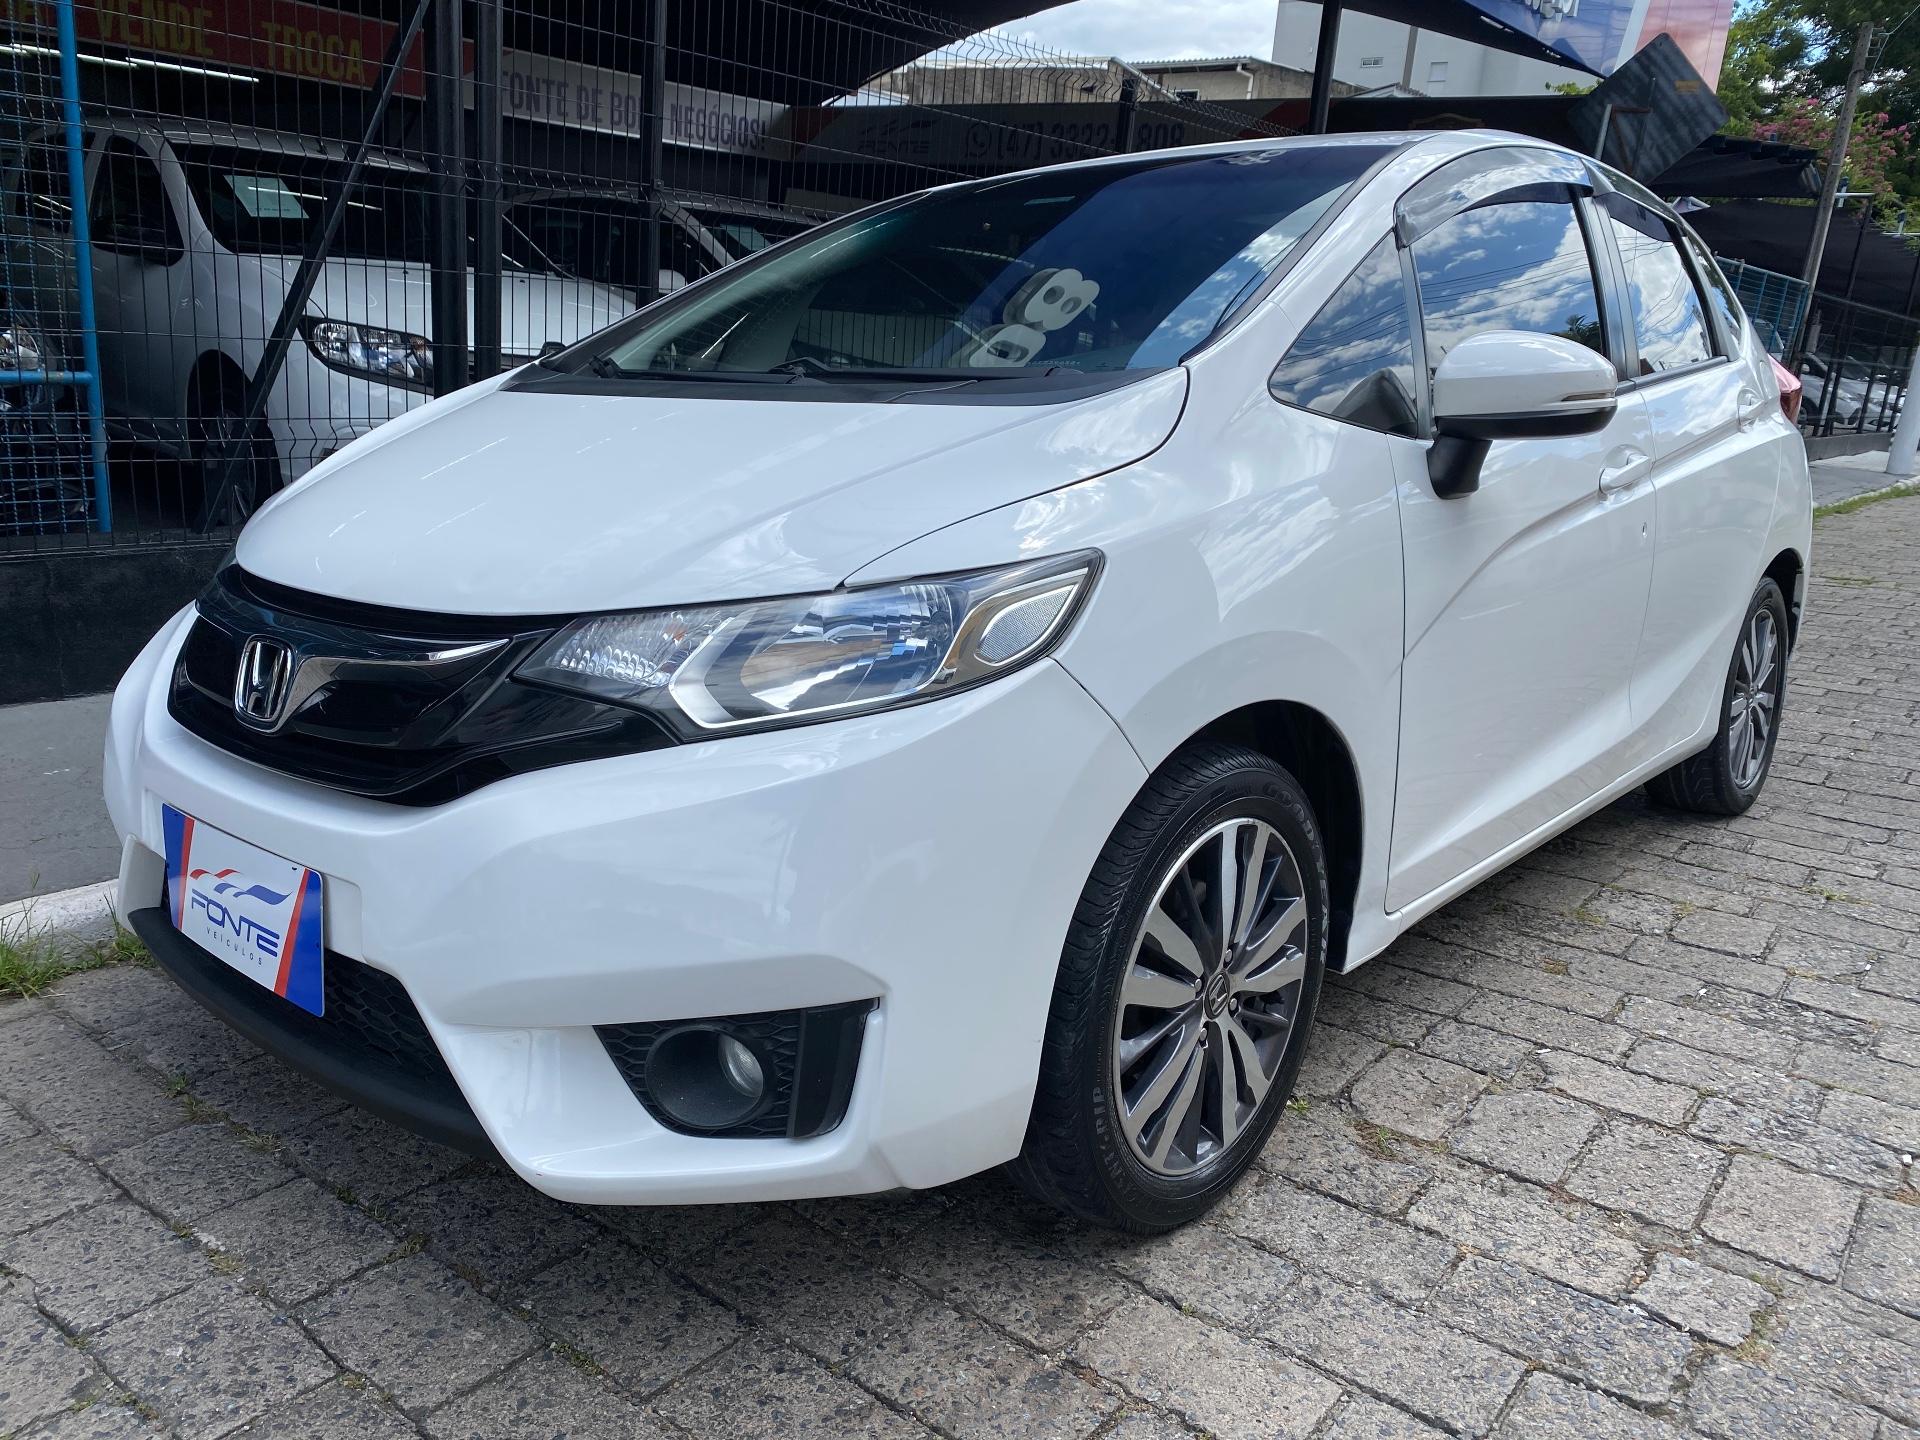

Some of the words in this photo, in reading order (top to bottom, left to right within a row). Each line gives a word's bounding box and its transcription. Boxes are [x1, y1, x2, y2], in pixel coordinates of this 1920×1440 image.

[93, 0, 214, 57] VENDE
[260, 20, 365, 82] TROCA
[576, 85, 602, 123] DE
[609, 92, 641, 129] BO
[669, 102, 766, 151] NEGÓCIOS!
[191, 888, 281, 958] FONTE
